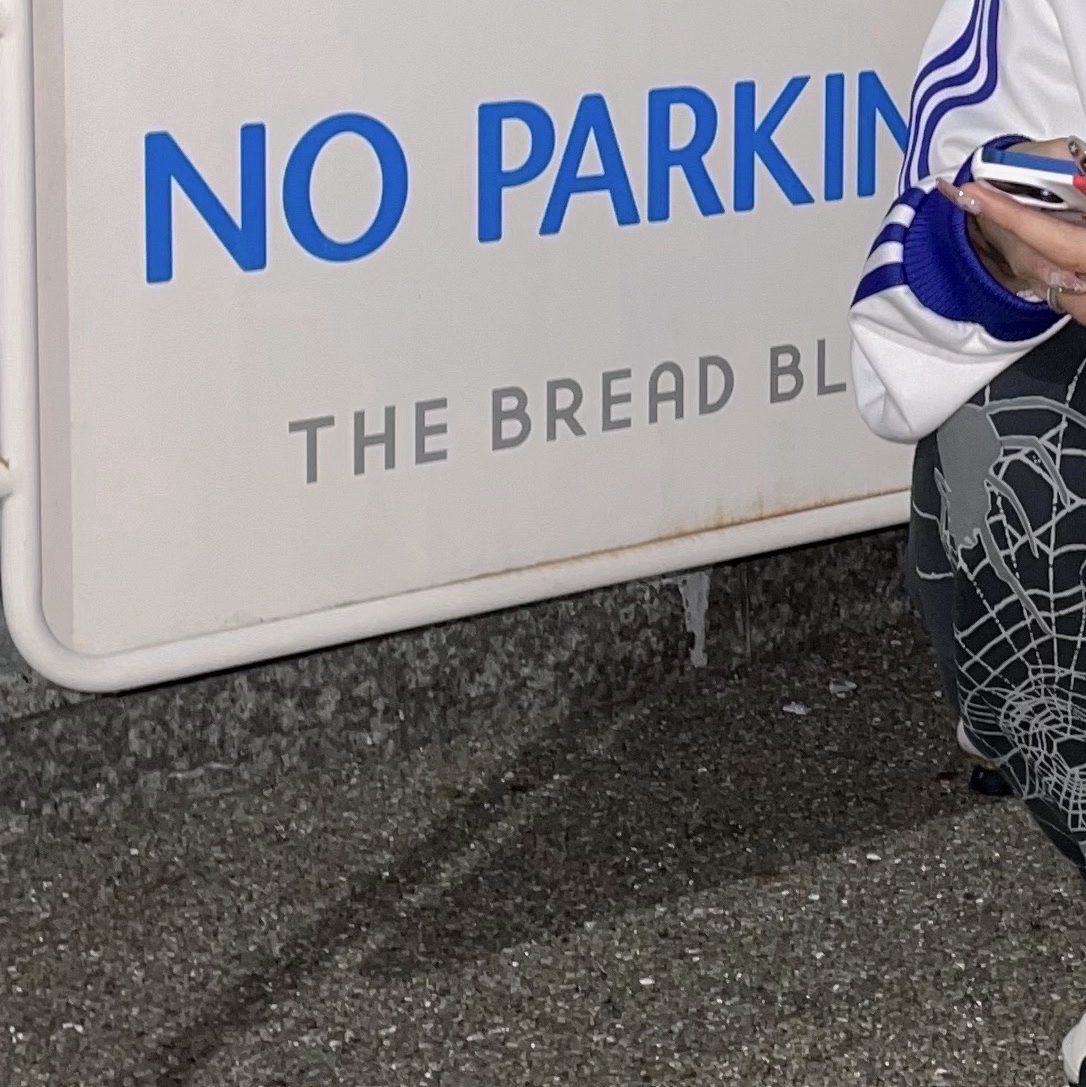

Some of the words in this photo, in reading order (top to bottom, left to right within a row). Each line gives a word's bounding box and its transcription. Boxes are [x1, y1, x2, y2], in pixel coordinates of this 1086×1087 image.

[144, 112, 409, 284] NO
[477, 70, 910, 244] PARKIN
[289, 397, 449, 485] THE
[491, 354, 736, 452] BREAD
[769, 338, 847, 404] BL
